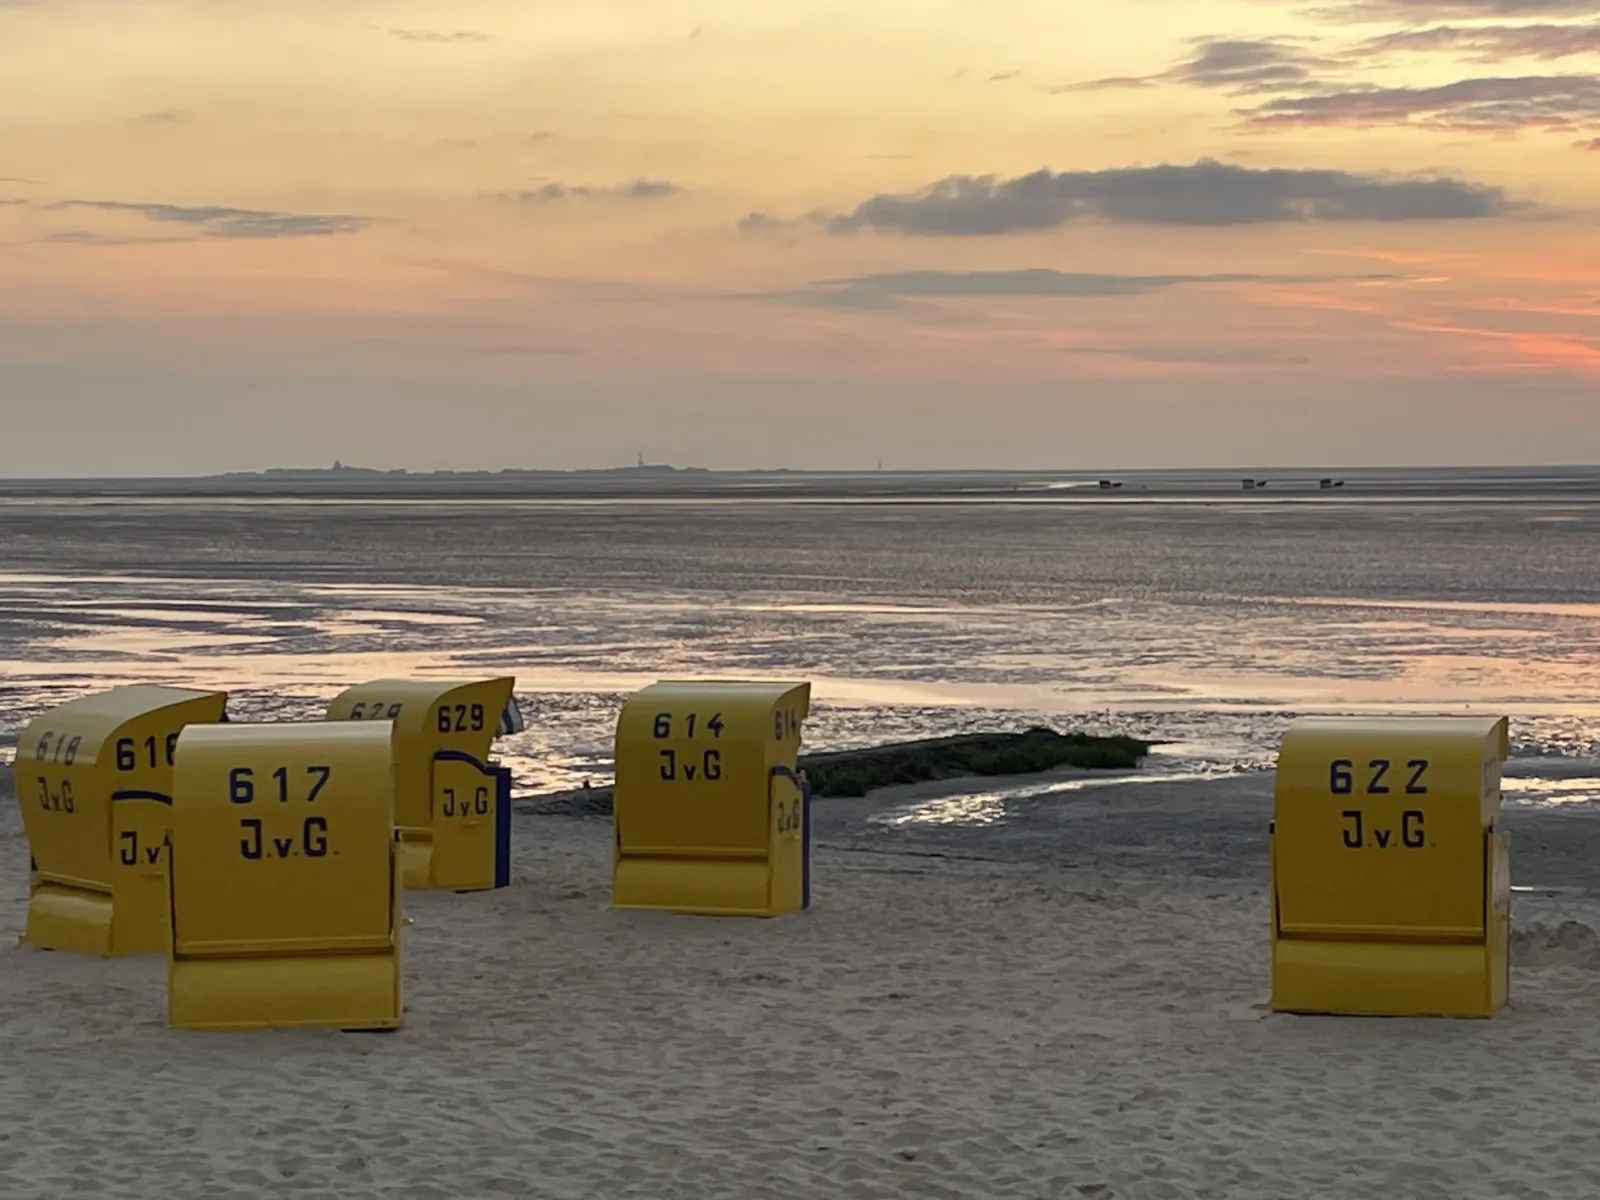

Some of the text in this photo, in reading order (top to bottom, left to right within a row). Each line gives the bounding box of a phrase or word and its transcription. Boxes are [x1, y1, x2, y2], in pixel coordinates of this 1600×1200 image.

[438, 704, 484, 733] 629
[653, 713, 725, 739] 614
[775, 709, 797, 741] 614
[36, 731, 82, 766] 618
[229, 766, 330, 804] 617
[1330, 759, 1429, 794] 622
[240, 816, 340, 860] J.v.G.
[1341, 810, 1437, 849] J.v.G.
